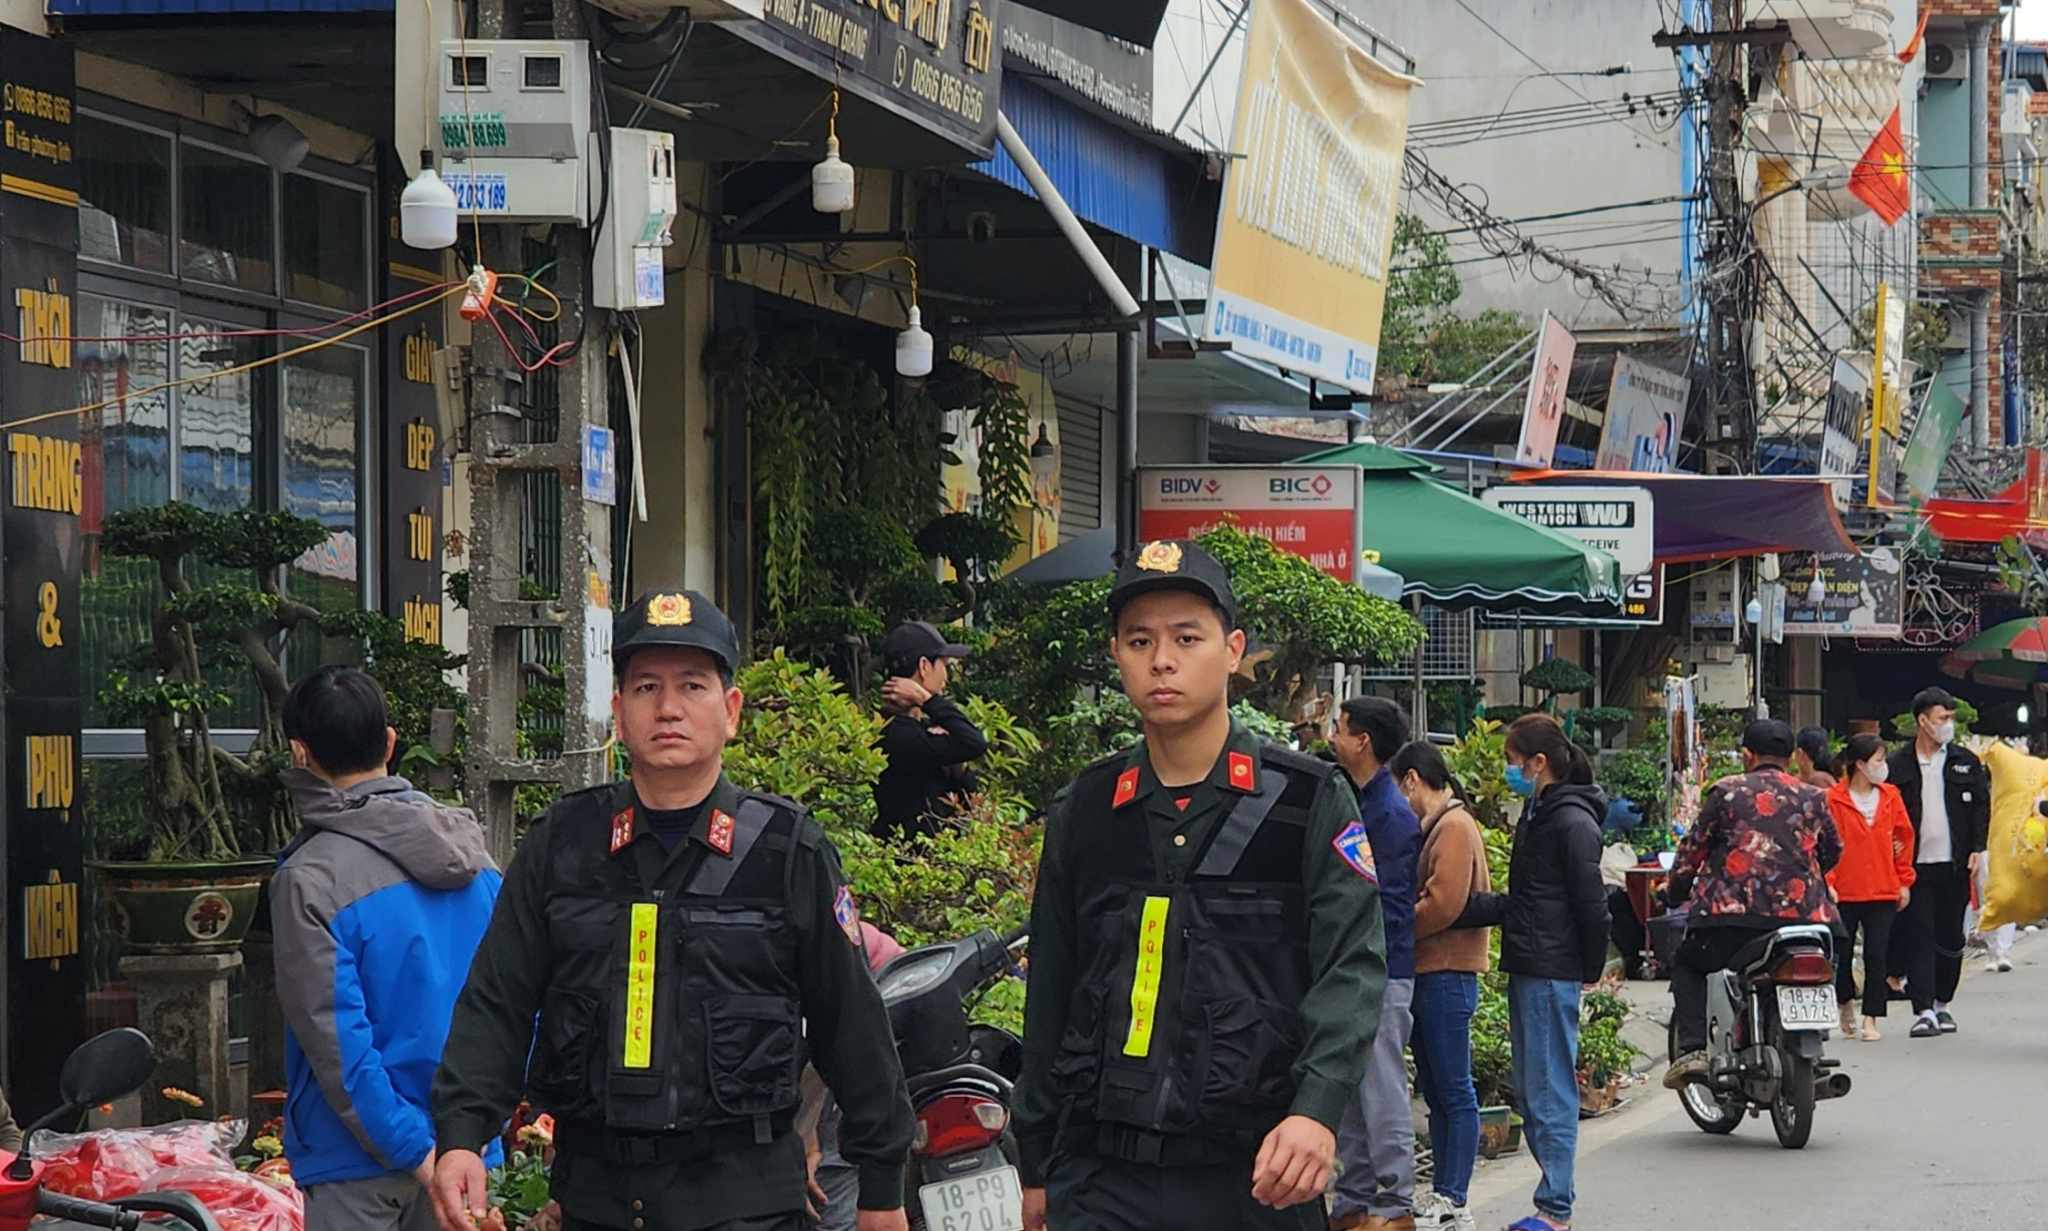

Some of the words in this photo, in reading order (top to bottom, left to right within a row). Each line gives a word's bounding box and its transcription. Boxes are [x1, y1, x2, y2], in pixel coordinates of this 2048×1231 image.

[911, 57, 940, 103] 0866
[940, 72, 962, 113] 856
[962, 84, 984, 123] 656
[407, 416, 434, 471] DÉP
[8, 432, 82, 516] TRANG
[1161, 478, 1202, 494] BIDV
[408, 506, 432, 561] TÚI
[1503, 503, 1577, 515] WESTERN
[1526, 514, 1577, 526] UNION
[1580, 503, 1628, 526] WU
[36, 581, 64, 648] &
[26, 735, 74, 824] PHỤ
[24, 869, 79, 972] KIỆN
[634, 930, 648, 1041] POLICE
[1135, 920, 1157, 1032] POLICE
[937, 1174, 1006, 1212] 18-P9
[942, 1202, 1013, 1231] 6204
